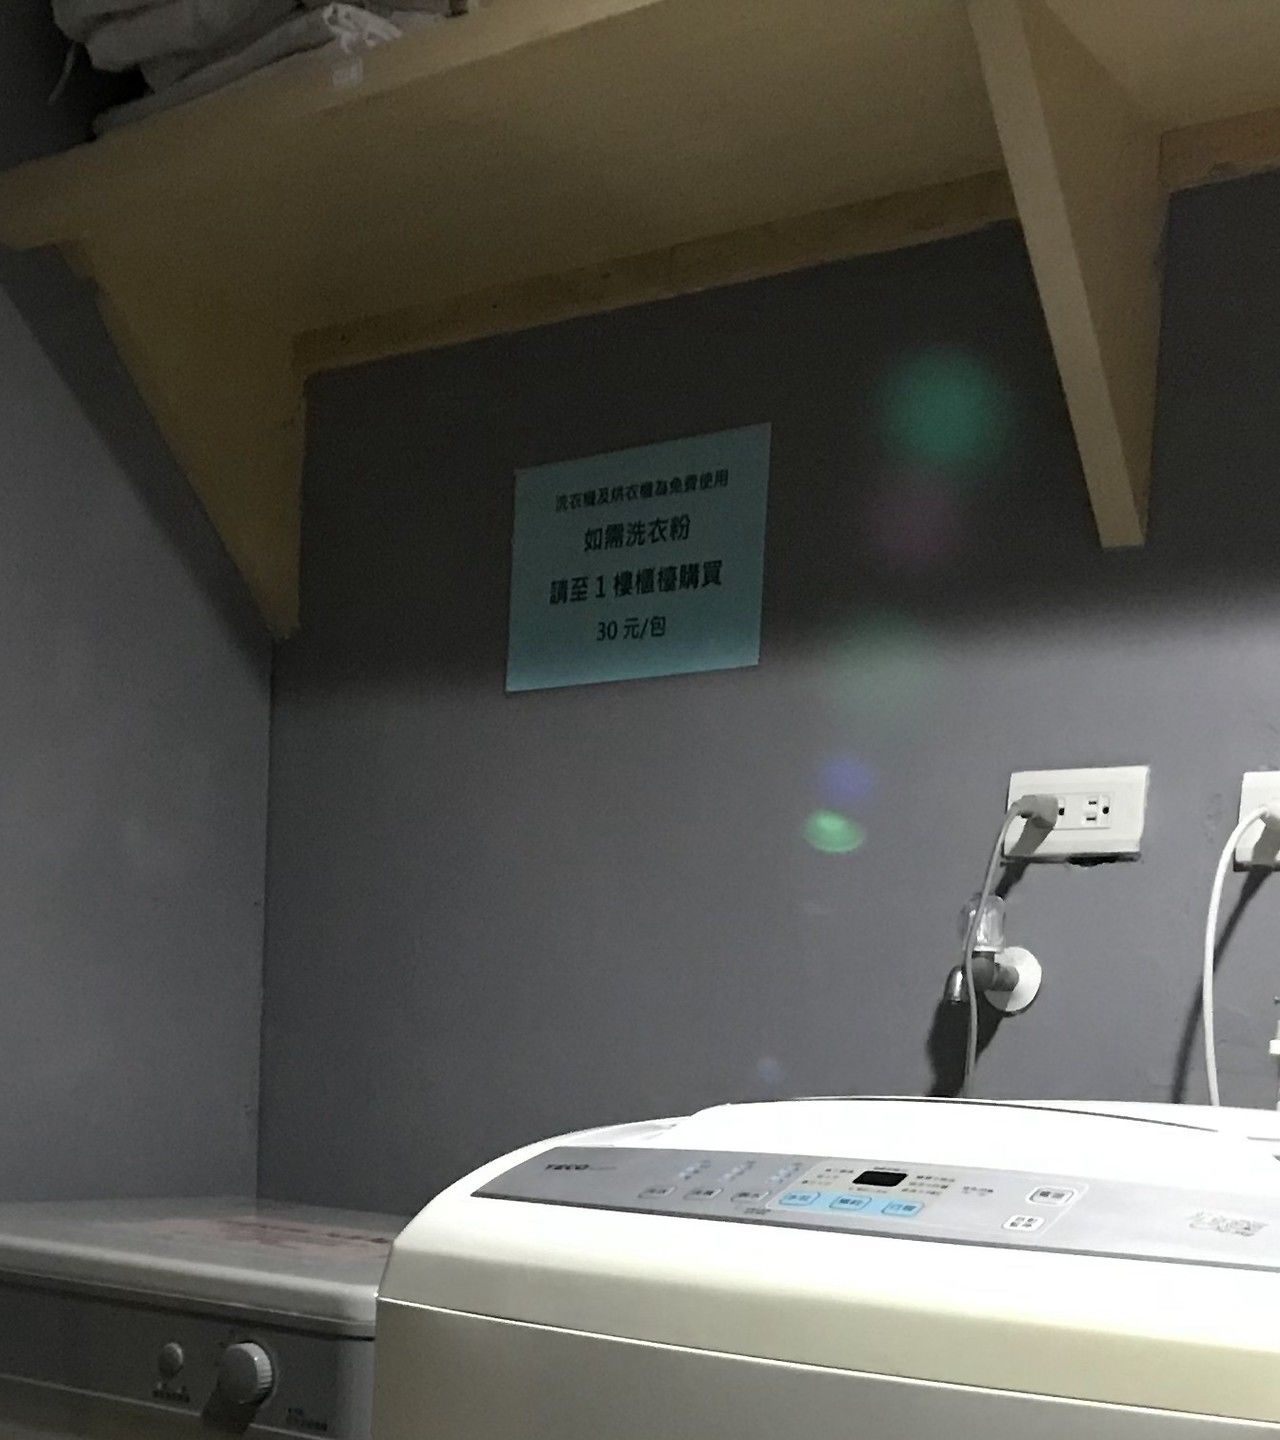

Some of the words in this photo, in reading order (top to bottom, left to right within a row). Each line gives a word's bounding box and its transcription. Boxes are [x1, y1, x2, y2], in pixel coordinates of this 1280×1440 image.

[584, 513, 691, 552] 如需洗衣粉
